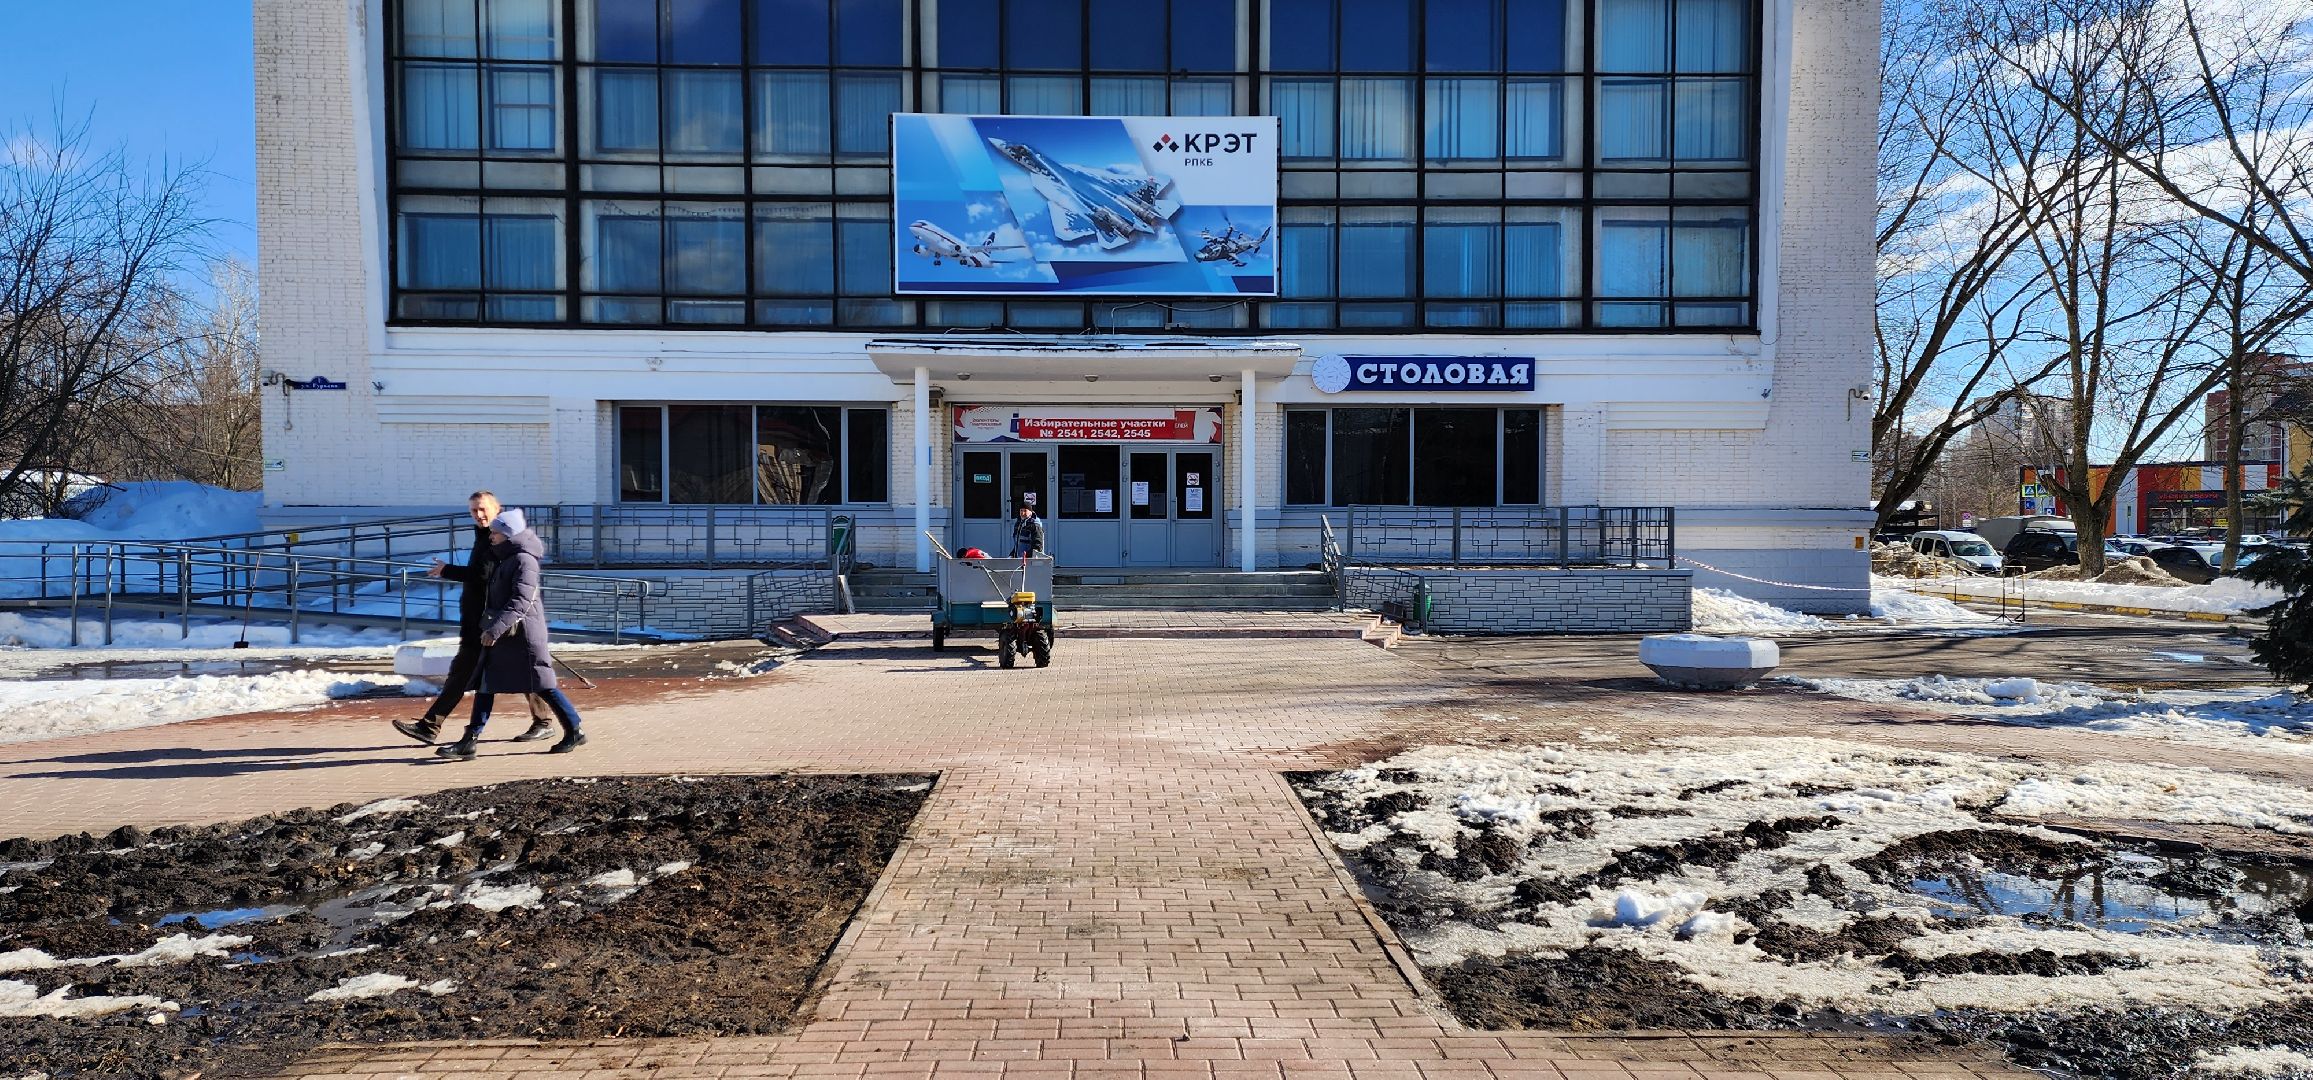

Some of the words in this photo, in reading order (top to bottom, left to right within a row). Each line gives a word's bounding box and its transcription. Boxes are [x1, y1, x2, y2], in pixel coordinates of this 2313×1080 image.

[1185, 133, 1257, 153] КРЭТ
[1185, 158, 1213, 166] РПКБ
[1357, 363, 1529, 384] СТОЛОВАЯ
[1024, 419, 1117, 428] Избирательные
[1040, 429, 1053, 437] №
[1057, 429, 1087, 438] 2541,
[1090, 429, 1121, 438] 2542,
[1123, 429, 1151, 437] 2545
